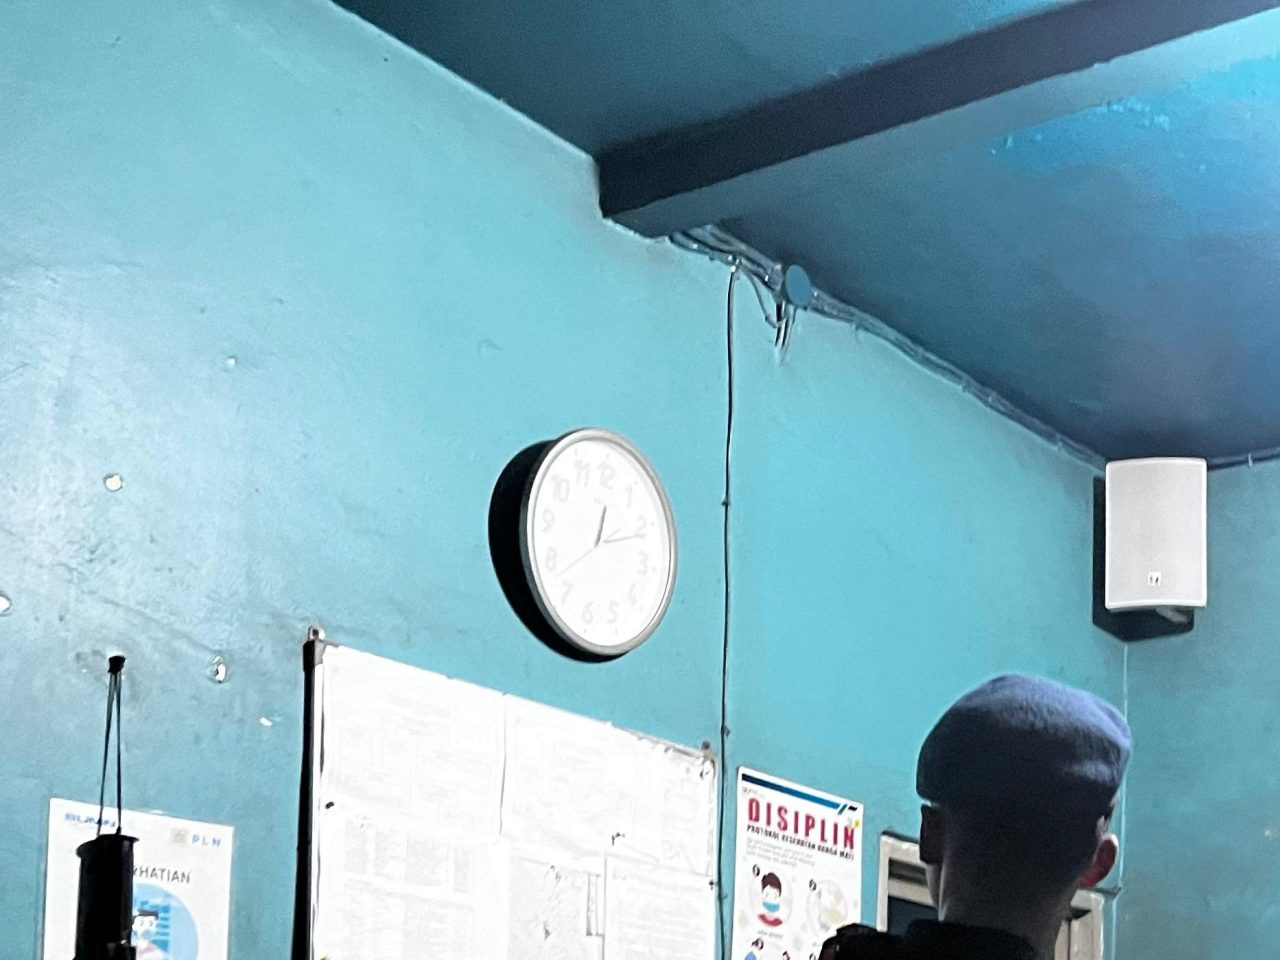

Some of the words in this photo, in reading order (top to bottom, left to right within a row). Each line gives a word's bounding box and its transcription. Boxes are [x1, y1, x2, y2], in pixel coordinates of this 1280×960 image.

[574, 459, 590, 488] 11
[598, 460, 616, 490] 12
[550, 473, 570, 503] 10
[624, 485, 634, 510] 1
[541, 507, 555, 533] 9
[636, 514, 648, 535] 2
[545, 546, 557, 573] 8
[637, 549, 649, 576] 3
[561, 580, 574, 606] 7
[582, 601, 595, 625] 6
[606, 600, 619, 625] 5
[748, 797, 855, 851] DISIPLIN
[191, 834, 222, 847] PLN
[133, 866, 190, 884] HATIAN
